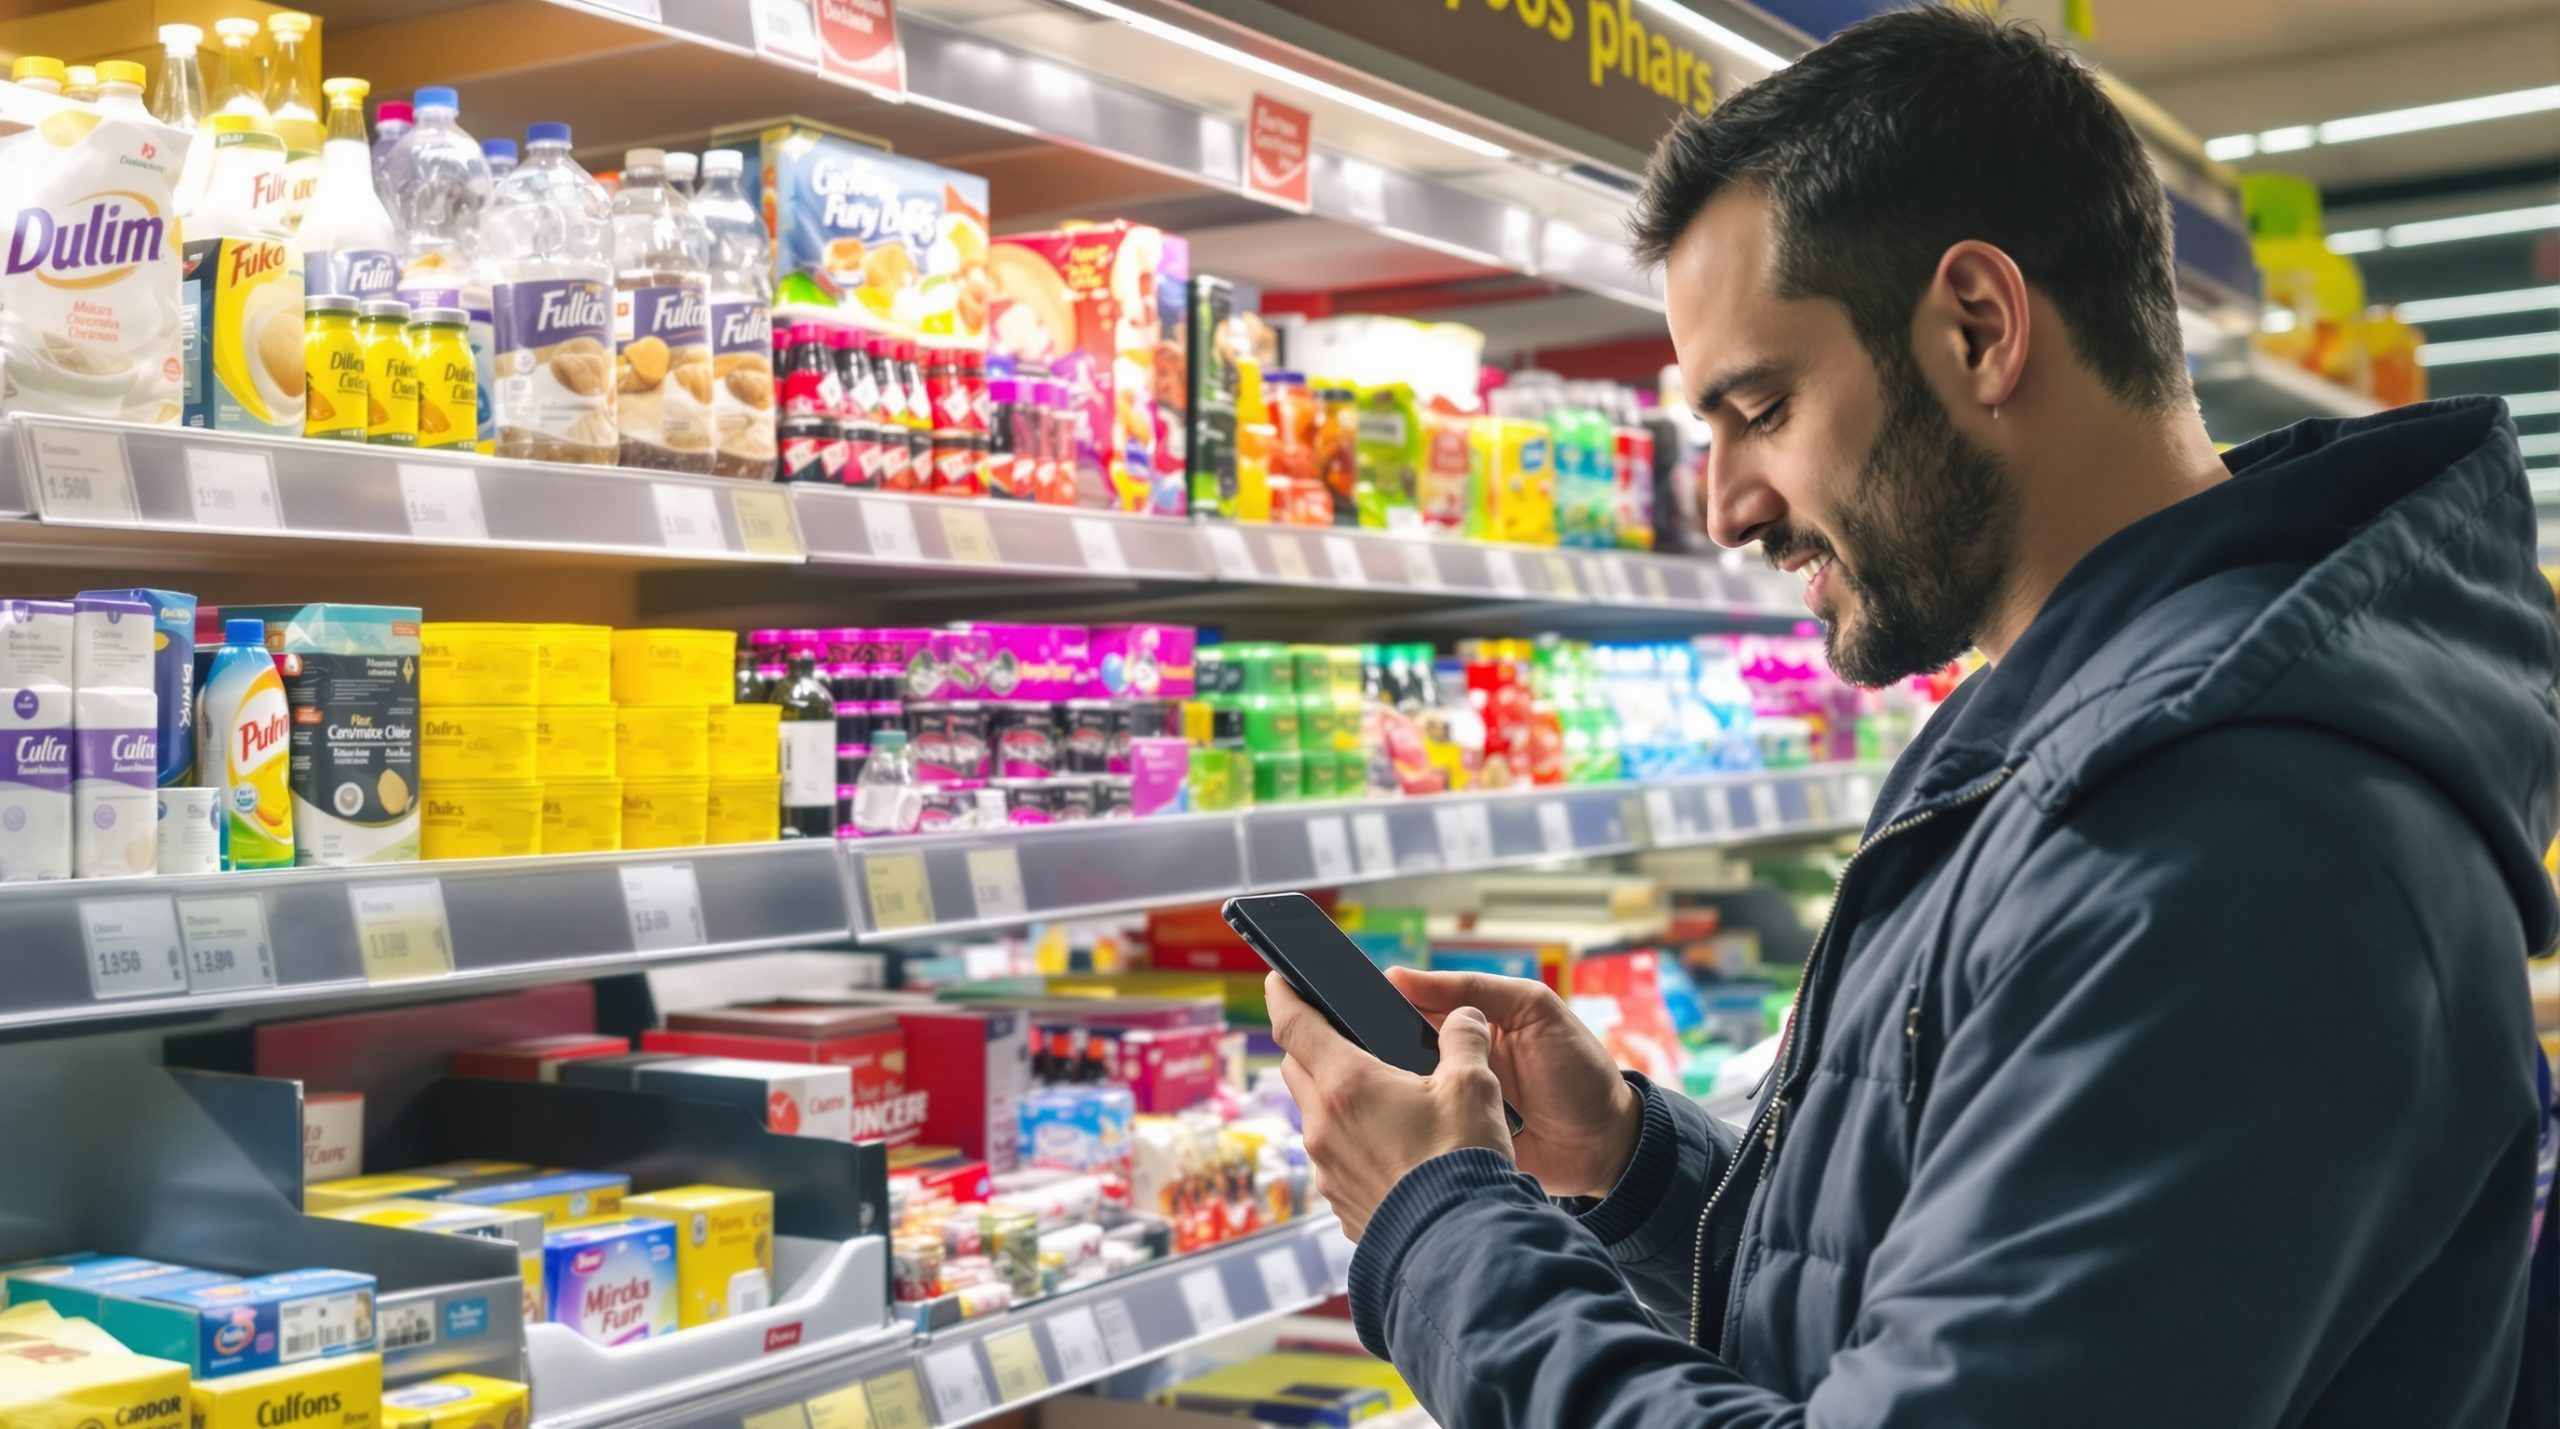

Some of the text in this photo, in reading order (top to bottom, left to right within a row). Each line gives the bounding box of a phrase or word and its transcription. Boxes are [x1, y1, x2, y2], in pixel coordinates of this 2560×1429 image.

[5, 203, 164, 275] Dulim
[230, 240, 286, 288] Fuko
[257, 1392, 341, 1428] Culfons
